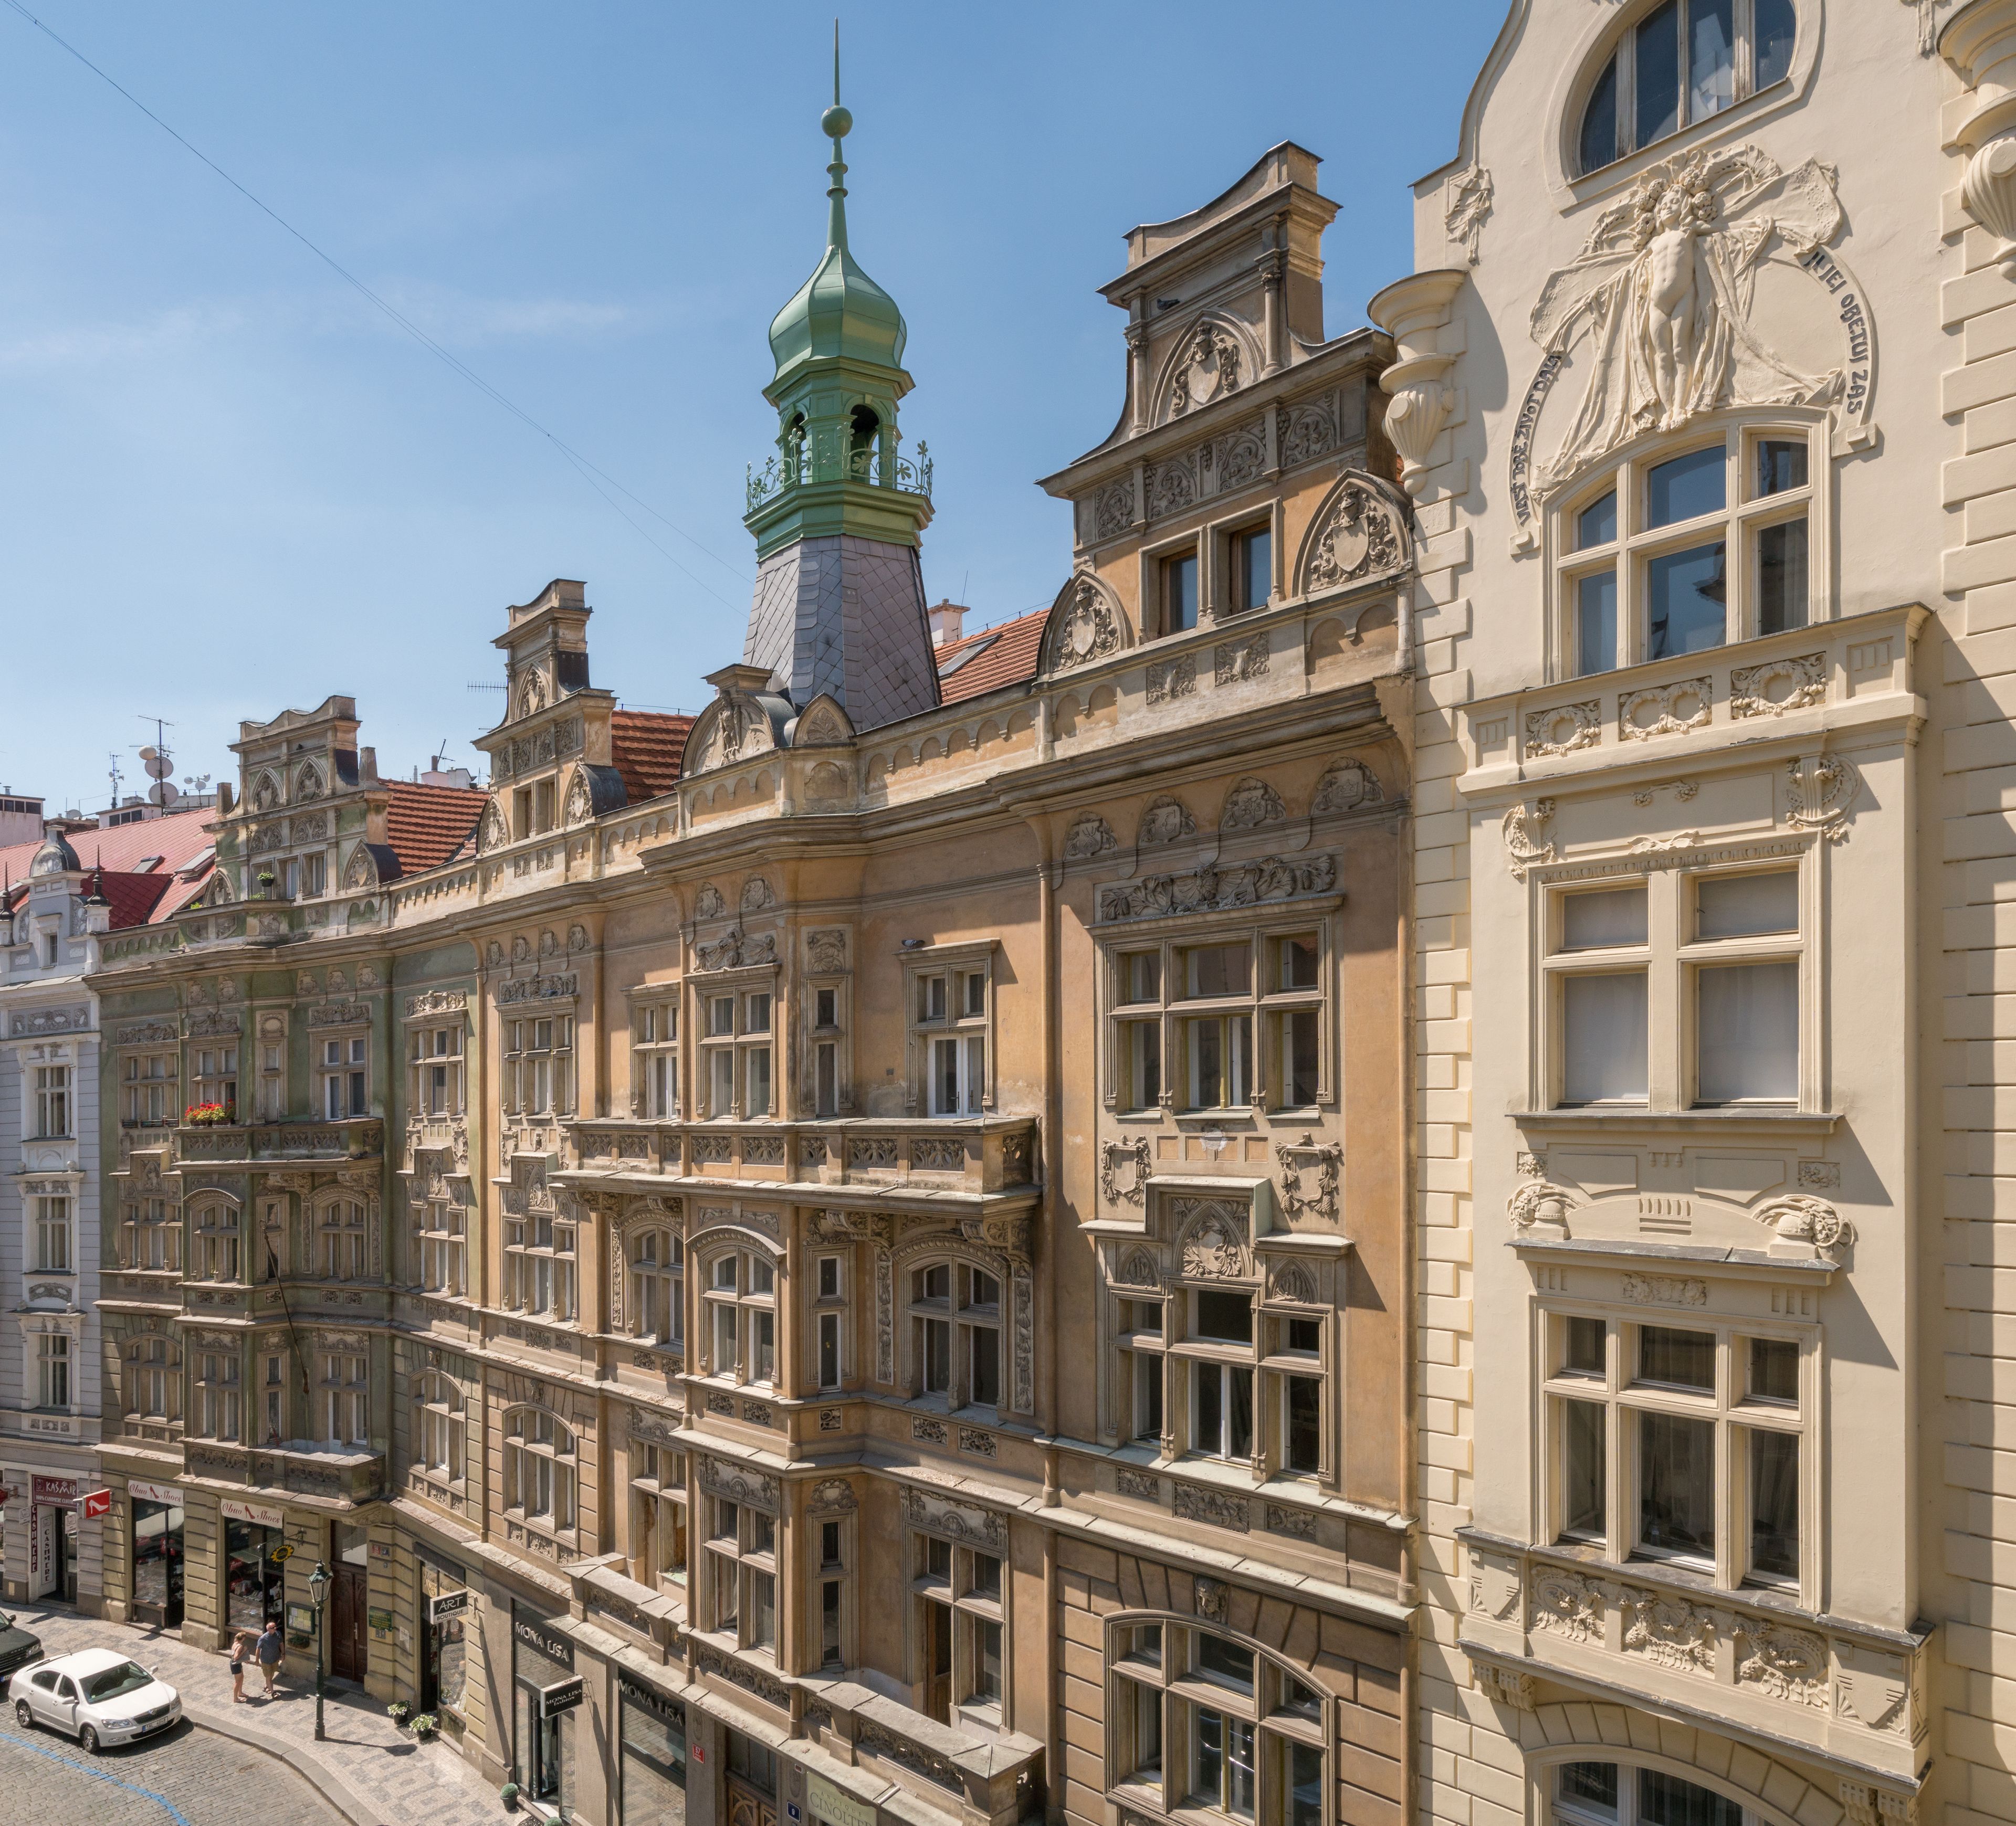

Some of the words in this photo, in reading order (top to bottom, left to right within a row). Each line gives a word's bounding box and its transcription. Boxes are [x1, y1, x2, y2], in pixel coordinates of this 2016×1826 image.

[1847, 370, 1868, 415] ZAS
[129, 1484, 147, 1495] Obuv
[161, 1491, 181, 1502] Shoes
[222, 1503, 242, 1515] Obuv
[257, 1510, 280, 1524] Shoes
[438, 1596, 463, 1612] ART
[437, 1609, 464, 1621] BOUTIQUE
[516, 1622, 545, 1648] MONA
[547, 1640, 570, 1662] LISA
[546, 1695, 566, 1705] MONA
[569, 1688, 582, 1697] LISA
[618, 1680, 653, 1709] MONA
[658, 1702, 682, 1726] LISA
[821, 1791, 862, 1817] ANTIQUE
